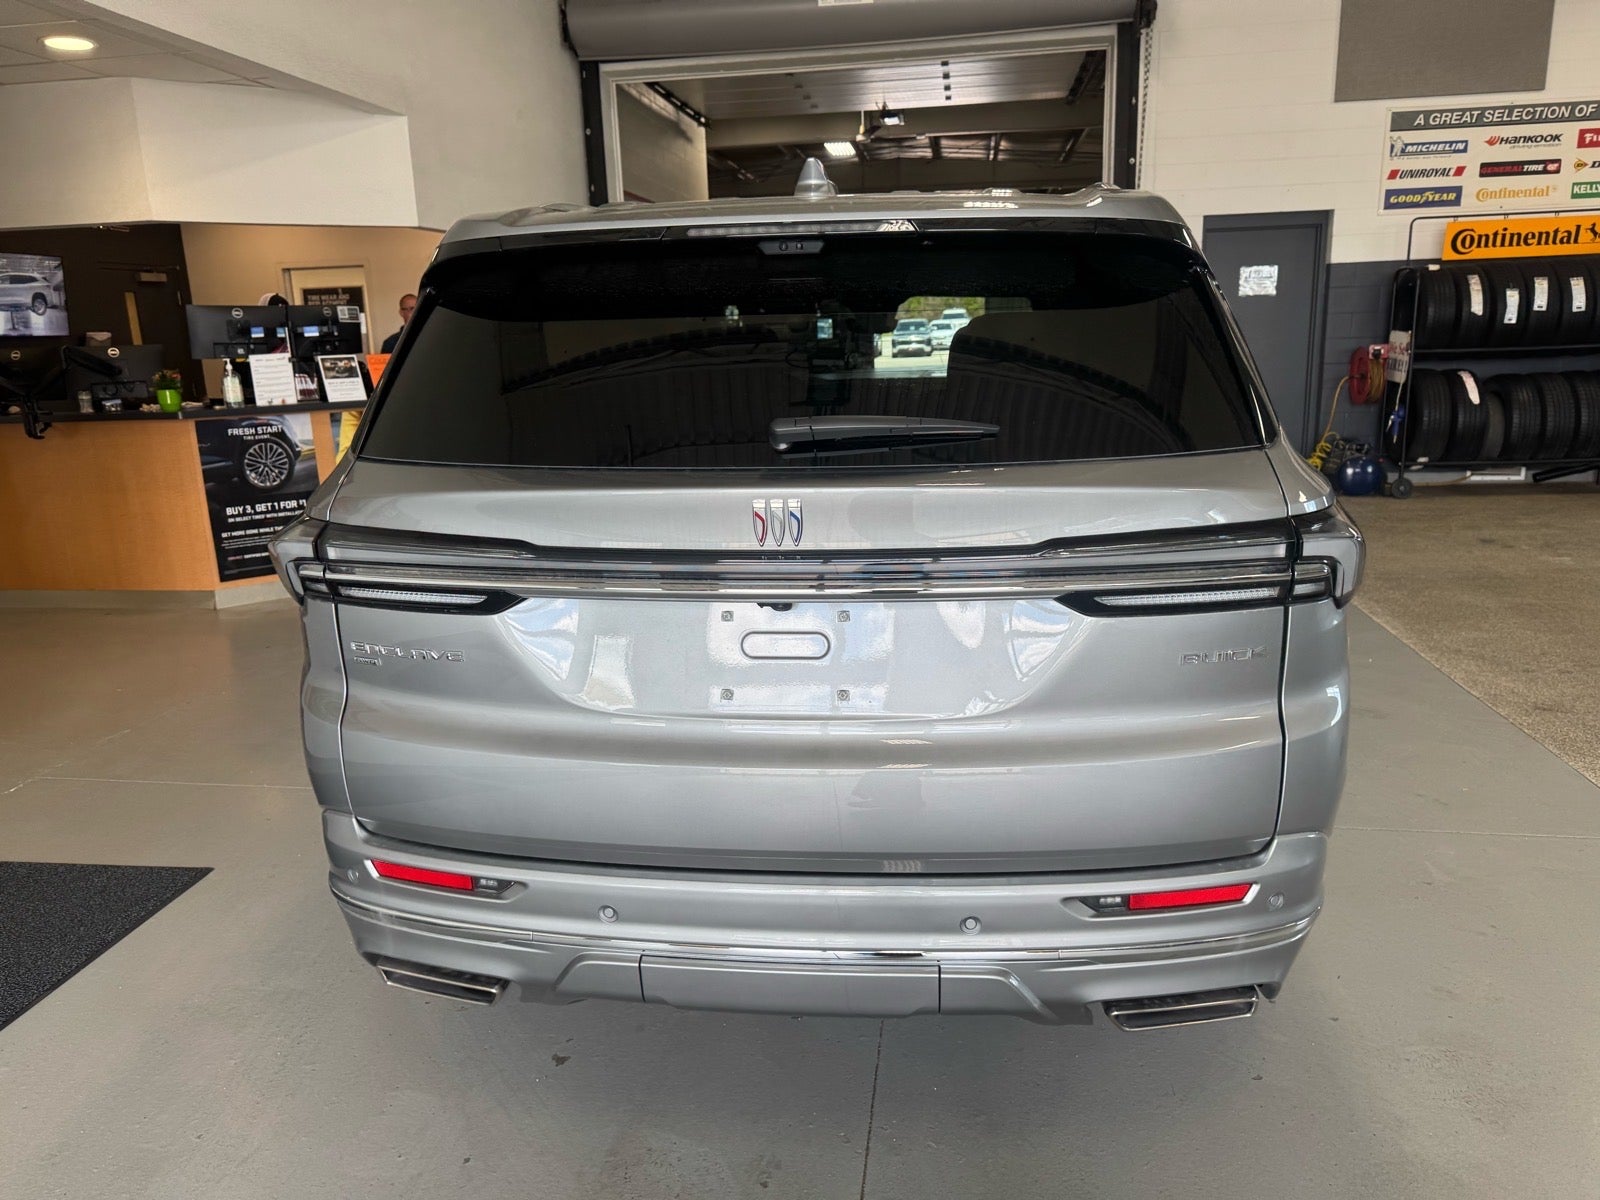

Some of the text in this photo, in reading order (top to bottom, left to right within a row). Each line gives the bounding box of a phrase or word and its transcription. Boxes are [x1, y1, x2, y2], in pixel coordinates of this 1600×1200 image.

[1413, 103, 1598, 126] A GREAT SELECTION OF
[1404, 142, 1466, 153] MICHELIN
[1398, 167, 1454, 179] UNIROYAL
[1480, 165, 1523, 174] GENERAL
[1522, 164, 1545, 172] TIRE
[1389, 191, 1457, 204] GOODYEAR
[1475, 185, 1550, 203] Continental
[1450, 224, 1582, 255] Continental
[227, 424, 283, 436] FRESH START
[226, 505, 244, 516] BUY
[245, 504, 254, 514] 3,
[255, 502, 272, 512] GET
[273, 501, 279, 510] 1
[280, 500, 298, 510] FOR
[350, 640, 465, 662] ENCLAVE
[1178, 645, 1266, 665] BUICK
